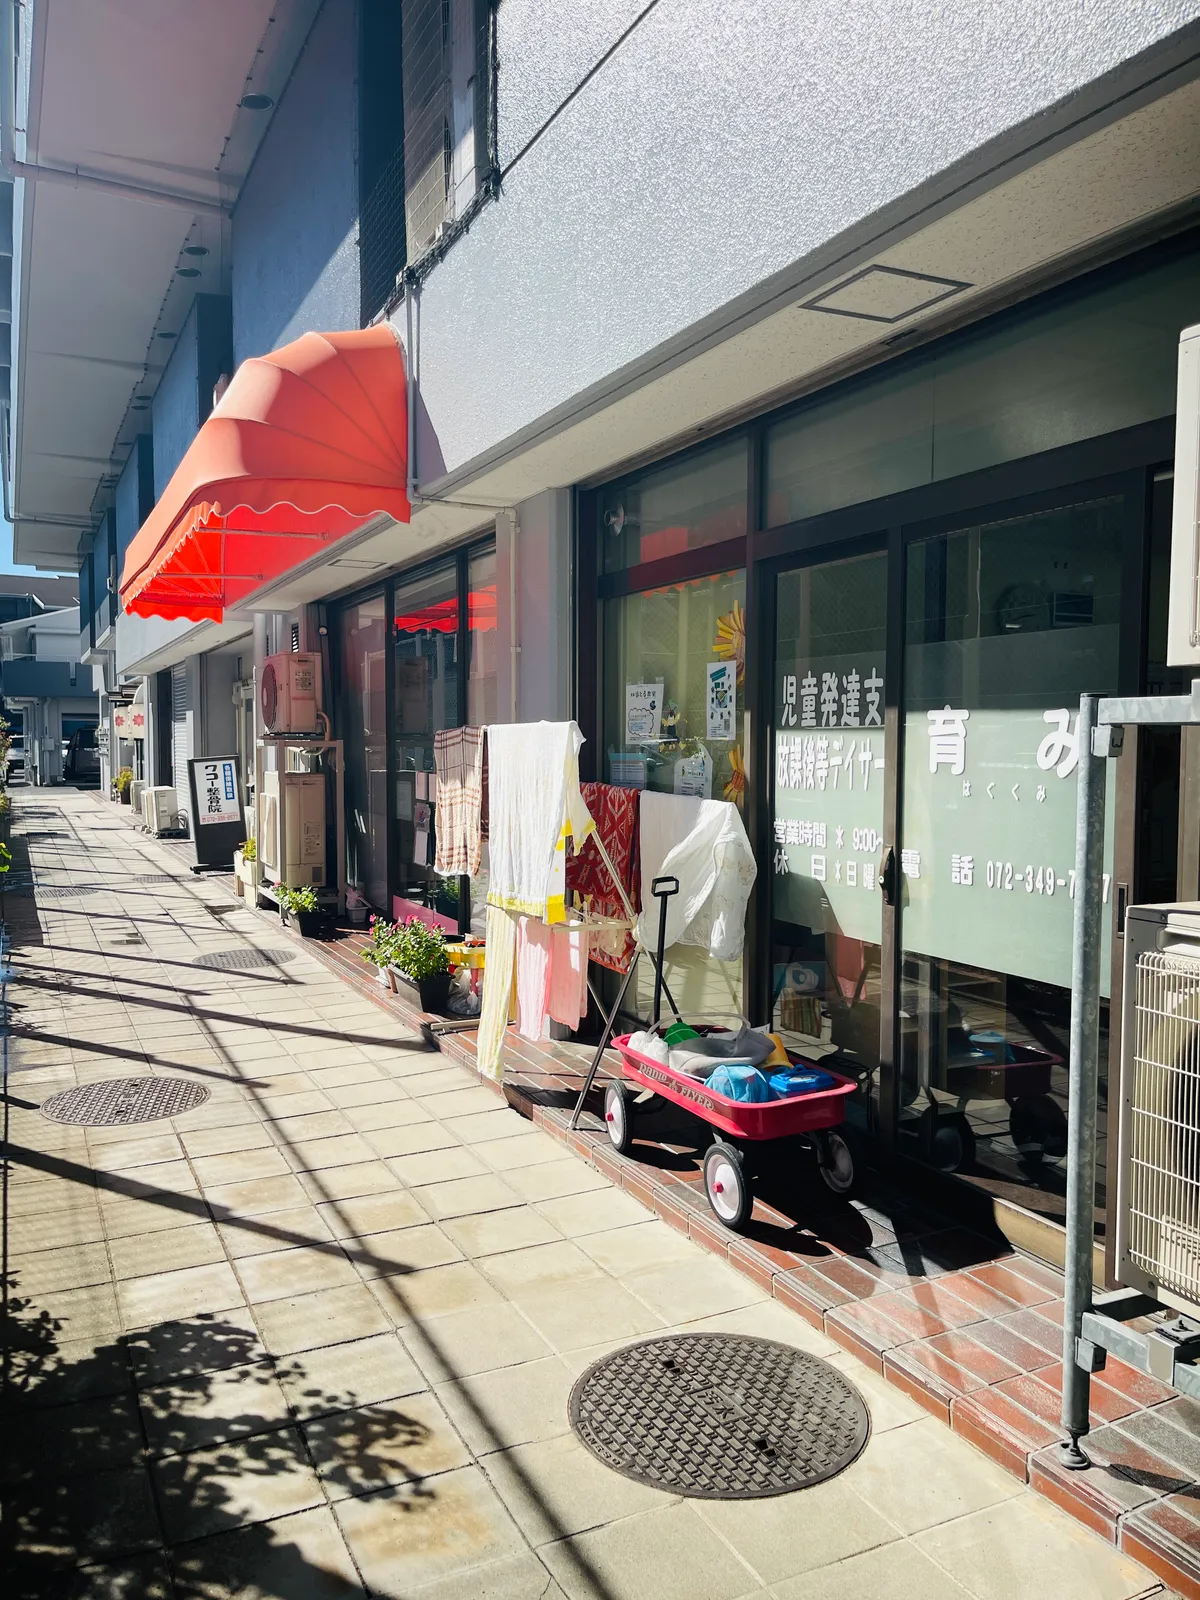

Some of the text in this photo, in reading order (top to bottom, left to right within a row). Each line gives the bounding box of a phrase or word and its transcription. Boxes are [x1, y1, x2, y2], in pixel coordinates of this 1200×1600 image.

[781, 667, 884, 727] 児童発達支
[204, 764, 222, 813] ワコー整骨院
[774, 817, 827, 849] 営業時間
[638, 1062, 715, 1112] RADIO FLYER
